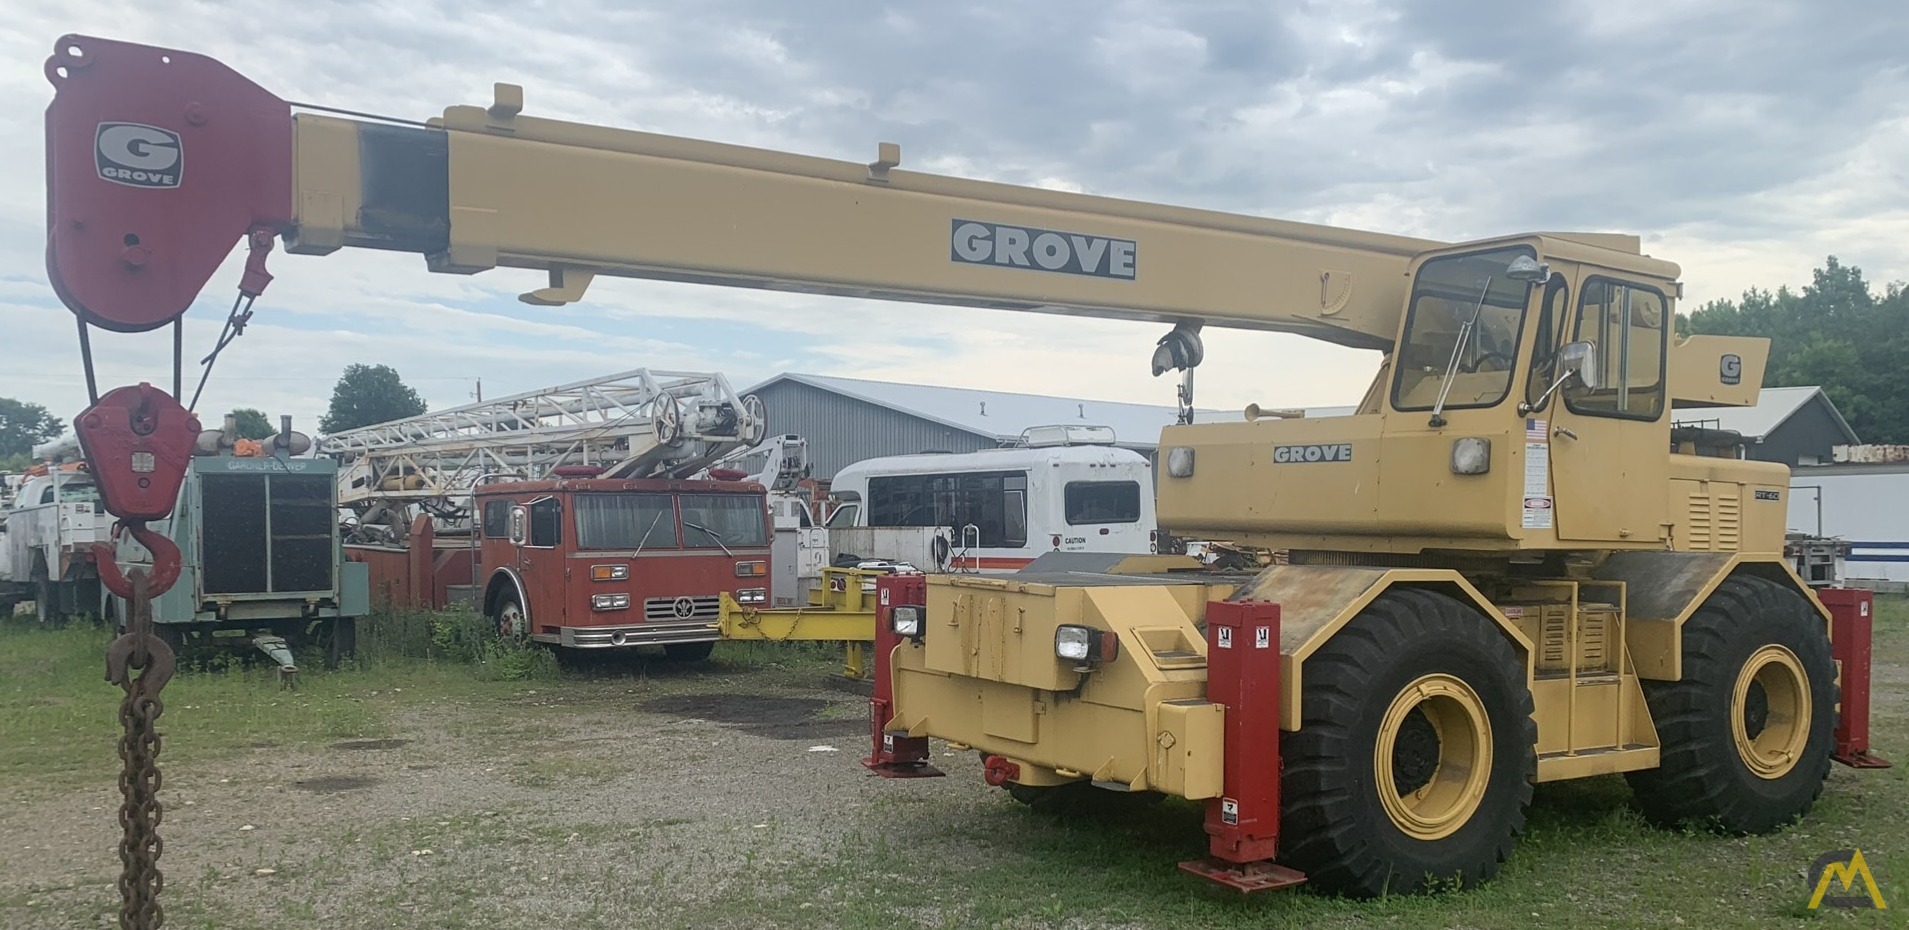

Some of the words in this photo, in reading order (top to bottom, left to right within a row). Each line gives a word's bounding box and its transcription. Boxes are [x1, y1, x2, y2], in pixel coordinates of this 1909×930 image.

[99, 125, 178, 170] G
[102, 167, 173, 185] GROVE
[953, 222, 1135, 277] GROVE
[1721, 354, 1741, 377] G
[1274, 444, 1351, 463] GROVE
[227, 461, 307, 471] GARDNER-DENVER
[1065, 537, 1086, 545] CAUTION
